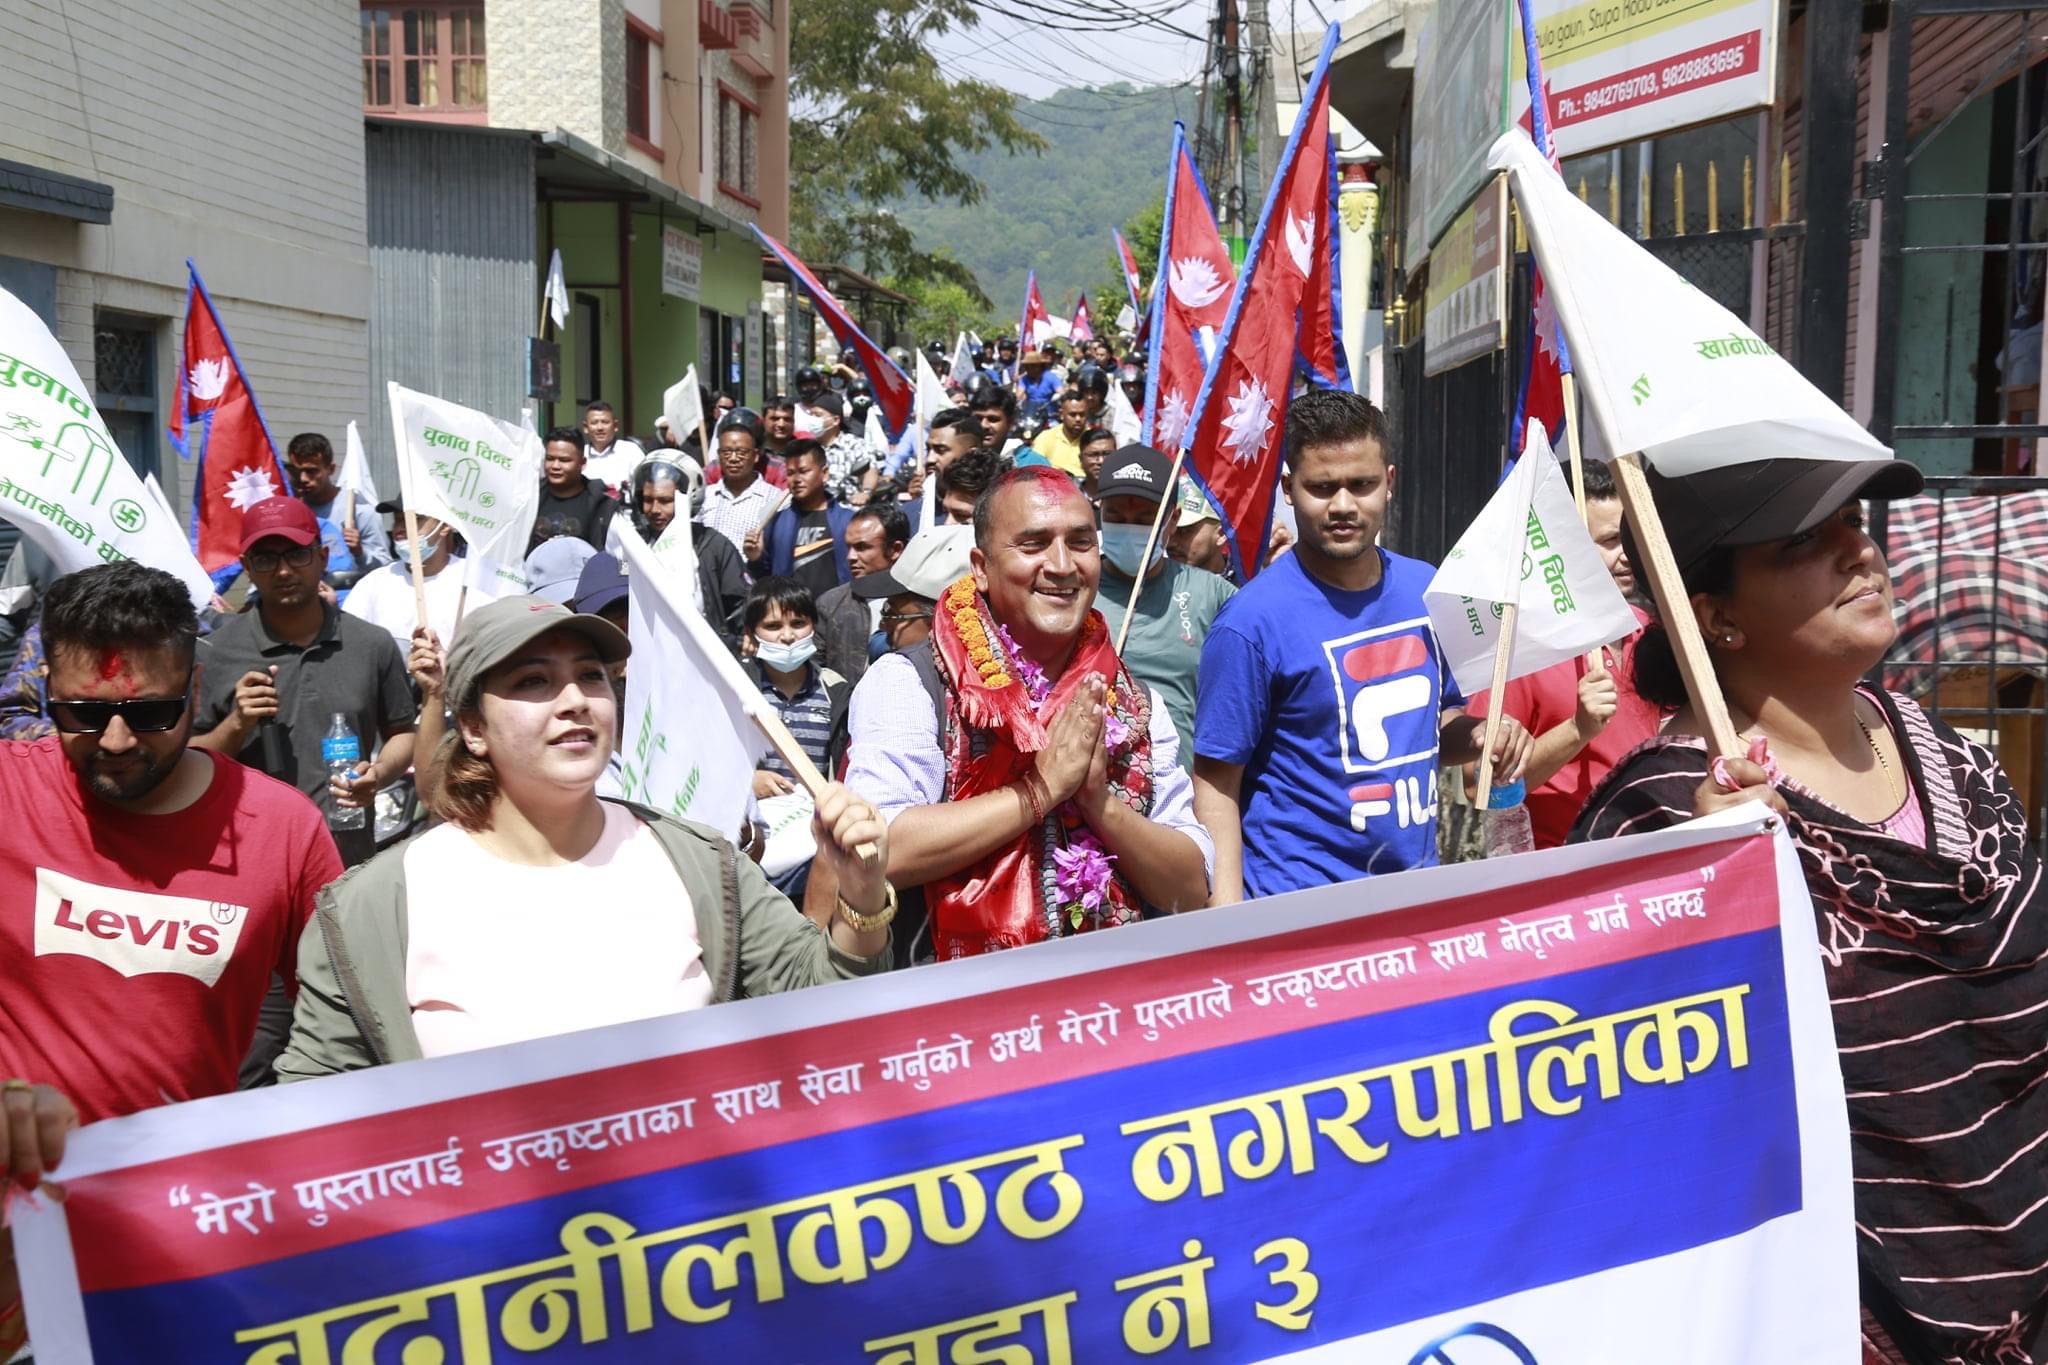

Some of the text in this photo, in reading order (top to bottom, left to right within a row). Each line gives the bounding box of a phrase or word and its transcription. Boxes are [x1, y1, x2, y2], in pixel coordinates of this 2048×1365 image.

[1558, 44, 1745, 119] Ph.: 9842769703, 9828883695
[423, 426, 470, 453] चुनाव
[1539, 554, 1576, 615] चिन्ह
[1348, 769, 1439, 832] FILA
[293, 1137, 464, 1227] पुस्तालाई
[481, 1098, 697, 1171] उत्कृष्टताका
[712, 1080, 782, 1124] साथ
[798, 1064, 864, 1106] सेवा
[880, 1038, 974, 1091] गर्नुको
[989, 1015, 1043, 1063] अर्थ
[1057, 1002, 1121, 1046] मेरो
[1133, 978, 1233, 1042] पुस्ताले
[1246, 946, 1417, 1008] उत्कृष्टताका
[1428, 931, 1488, 971] साथ
[1498, 915, 1576, 960] नेतृत्व
[1584, 893, 1630, 934] गर्न
[1119, 984, 1751, 1203] नगरपालिका
[1114, 1239, 1215, 1355] नं
[1253, 1237, 1320, 1330] ३
